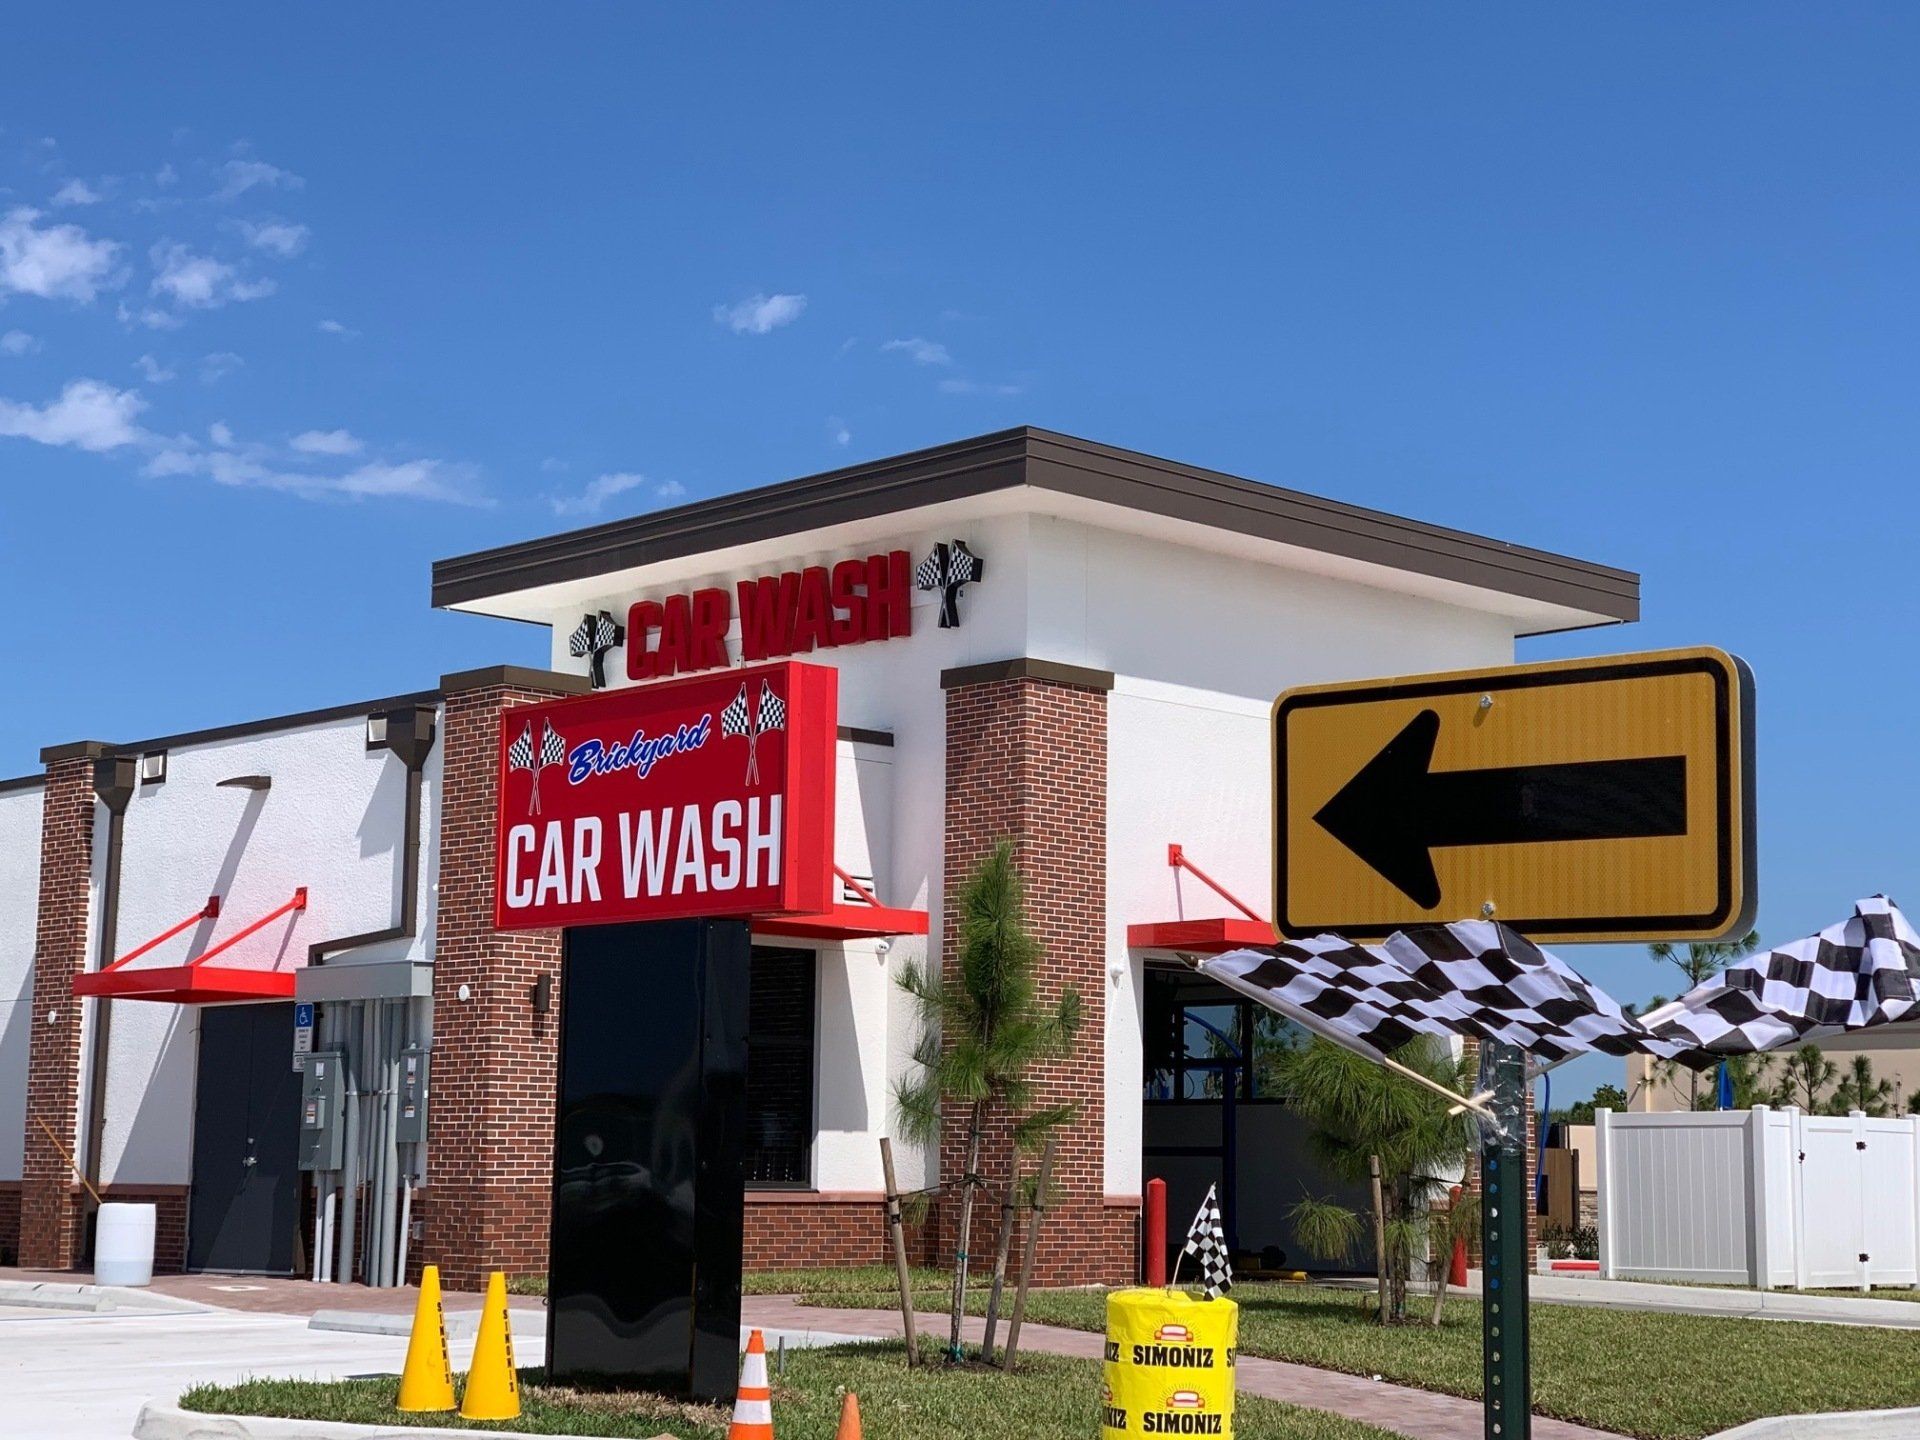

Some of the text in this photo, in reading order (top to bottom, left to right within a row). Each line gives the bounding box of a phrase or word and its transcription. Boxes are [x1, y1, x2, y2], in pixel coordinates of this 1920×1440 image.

[627, 550, 911, 681] CAR WASH
[568, 714, 712, 785] Brickyard
[506, 794, 782, 909] CAR WASH
[1133, 1344, 1213, 1368] SIMONIZ
[1143, 1411, 1221, 1434] SIMONIZ
